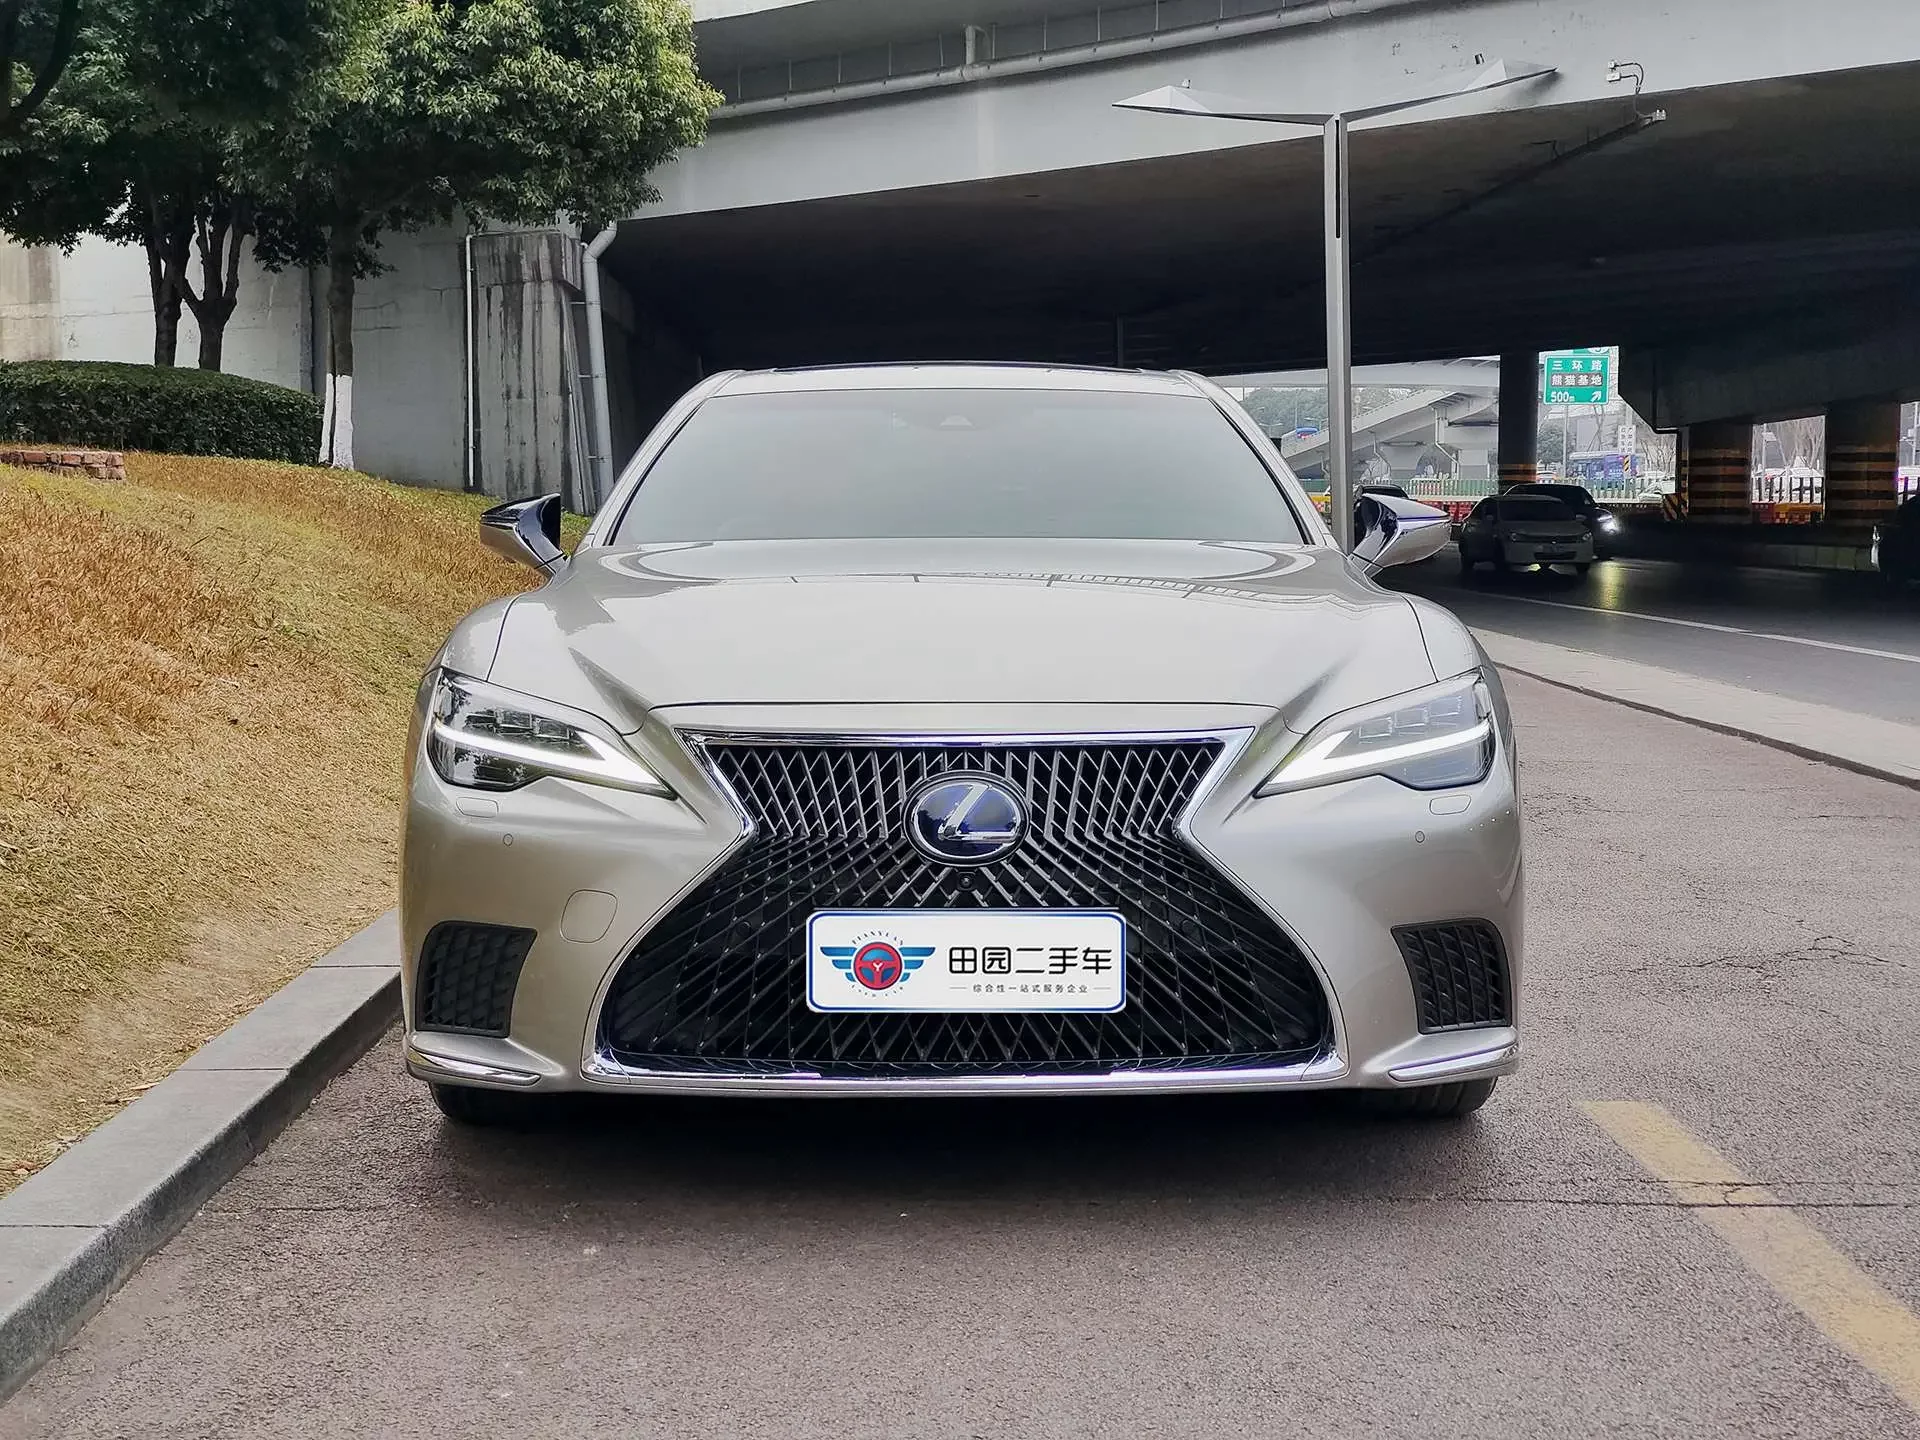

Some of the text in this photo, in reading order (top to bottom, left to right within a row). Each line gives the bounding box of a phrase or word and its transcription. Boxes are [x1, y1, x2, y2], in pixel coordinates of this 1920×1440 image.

[1551, 360, 1602, 371] 三环路
[1551, 374, 1602, 386] 熊猫基地
[949, 946, 1112, 975] 田园二手车
[972, 983, 1089, 994] 综合性一站式服务企业
